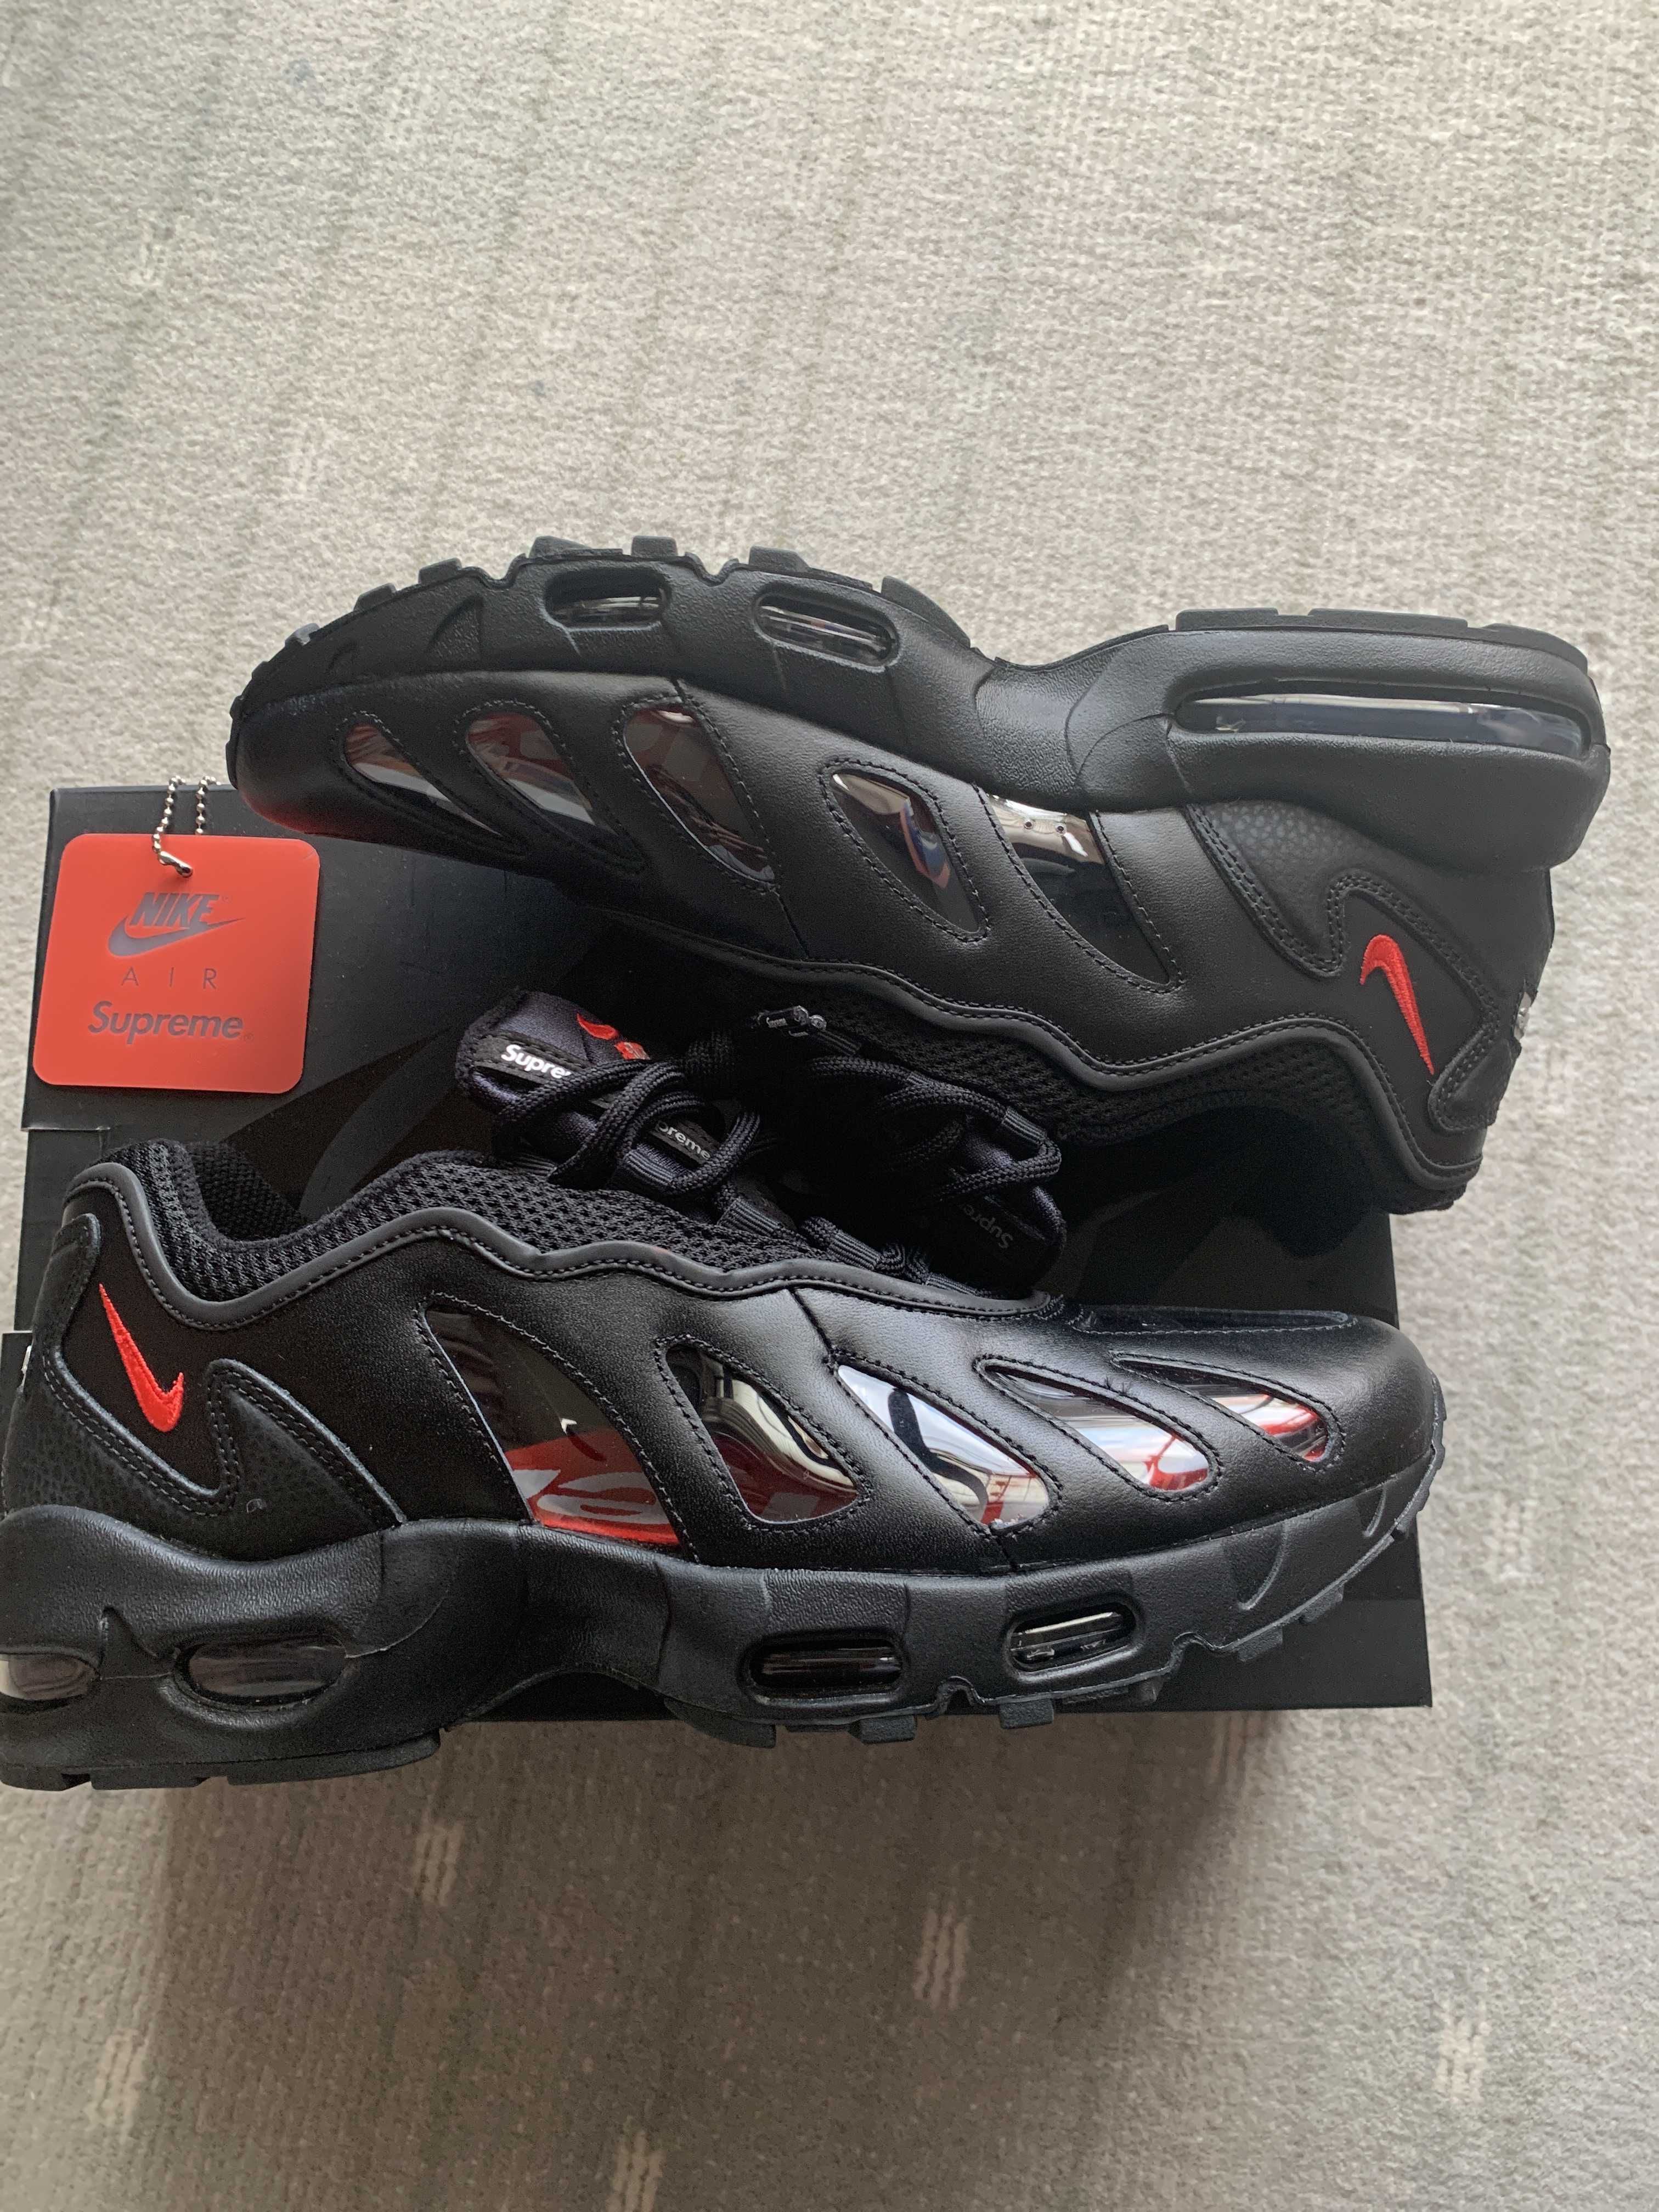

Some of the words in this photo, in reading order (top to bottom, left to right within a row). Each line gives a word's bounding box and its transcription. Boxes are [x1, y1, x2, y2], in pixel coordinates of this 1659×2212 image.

[129, 891, 219, 928] NIKE
[88, 1000, 244, 1045] Supreme
[501, 1044, 571, 1079] Supre
[655, 1121, 711, 1160] preme
[964, 1205, 1013, 1249] Supre
